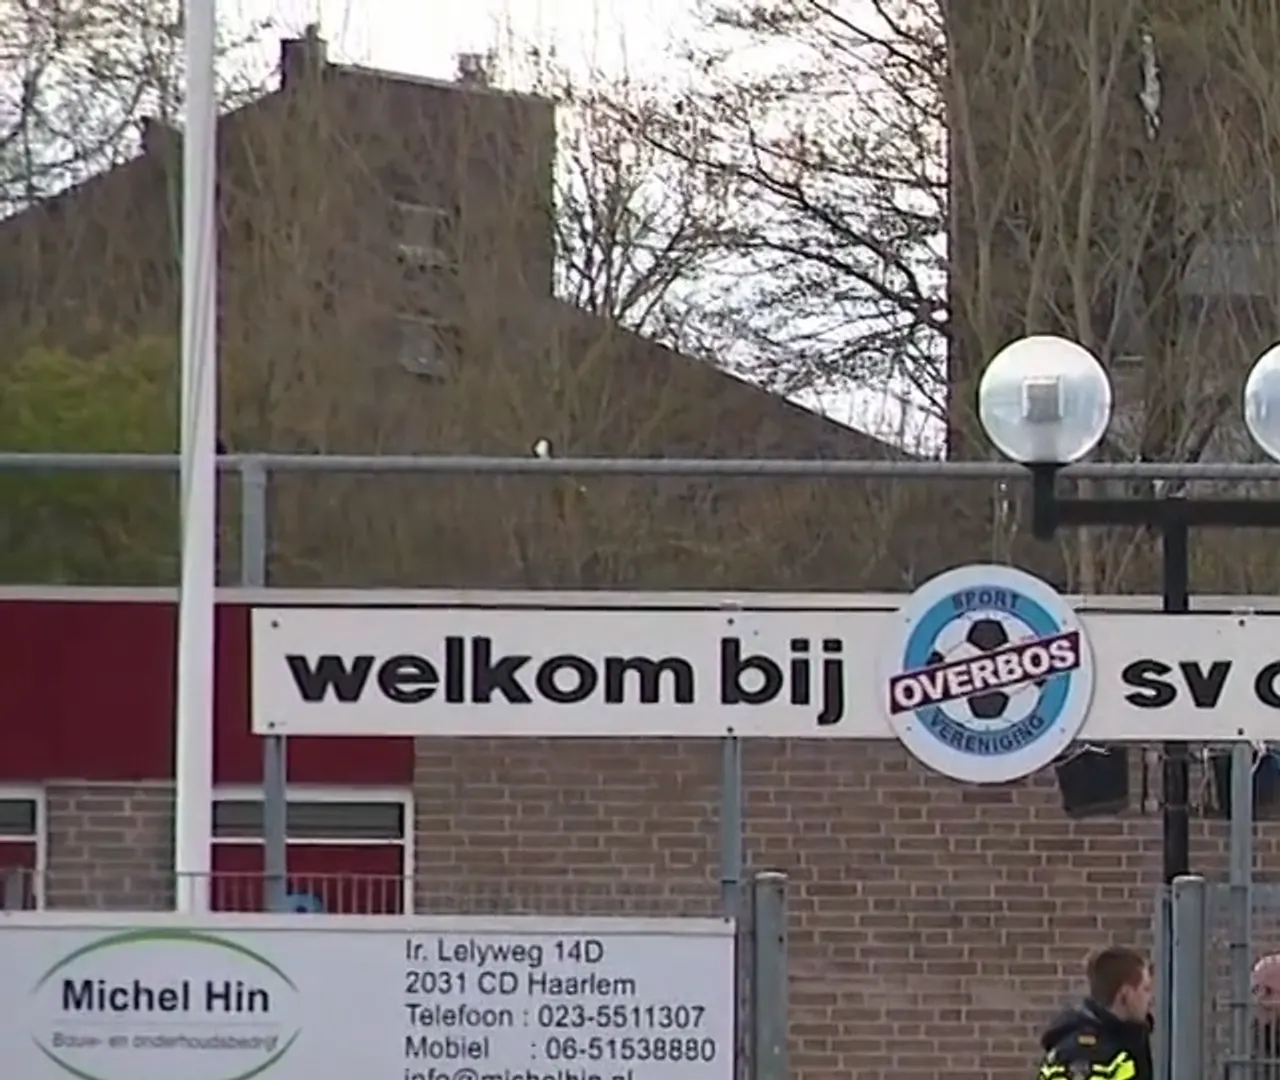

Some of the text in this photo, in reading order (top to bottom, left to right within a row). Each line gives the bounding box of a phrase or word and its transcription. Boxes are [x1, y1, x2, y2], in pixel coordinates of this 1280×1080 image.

[952, 590, 1021, 612] SPORT
[285, 636, 846, 726] welkom bij
[893, 640, 1076, 707] OVERBOS
[1121, 659, 1232, 708] sv
[930, 713, 1045, 754] VERENIGING
[405, 939, 603, 967] Ir. Lelyweg 14D
[62, 979, 270, 1012] Michel Hin
[405, 972, 635, 996] 2031 CD Haarlem
[405, 1004, 513, 1027] Telefoon
[538, 1005, 706, 1029] 023-5511307
[405, 1036, 489, 1059] Mobiel
[545, 1037, 716, 1061] 06-51538880
